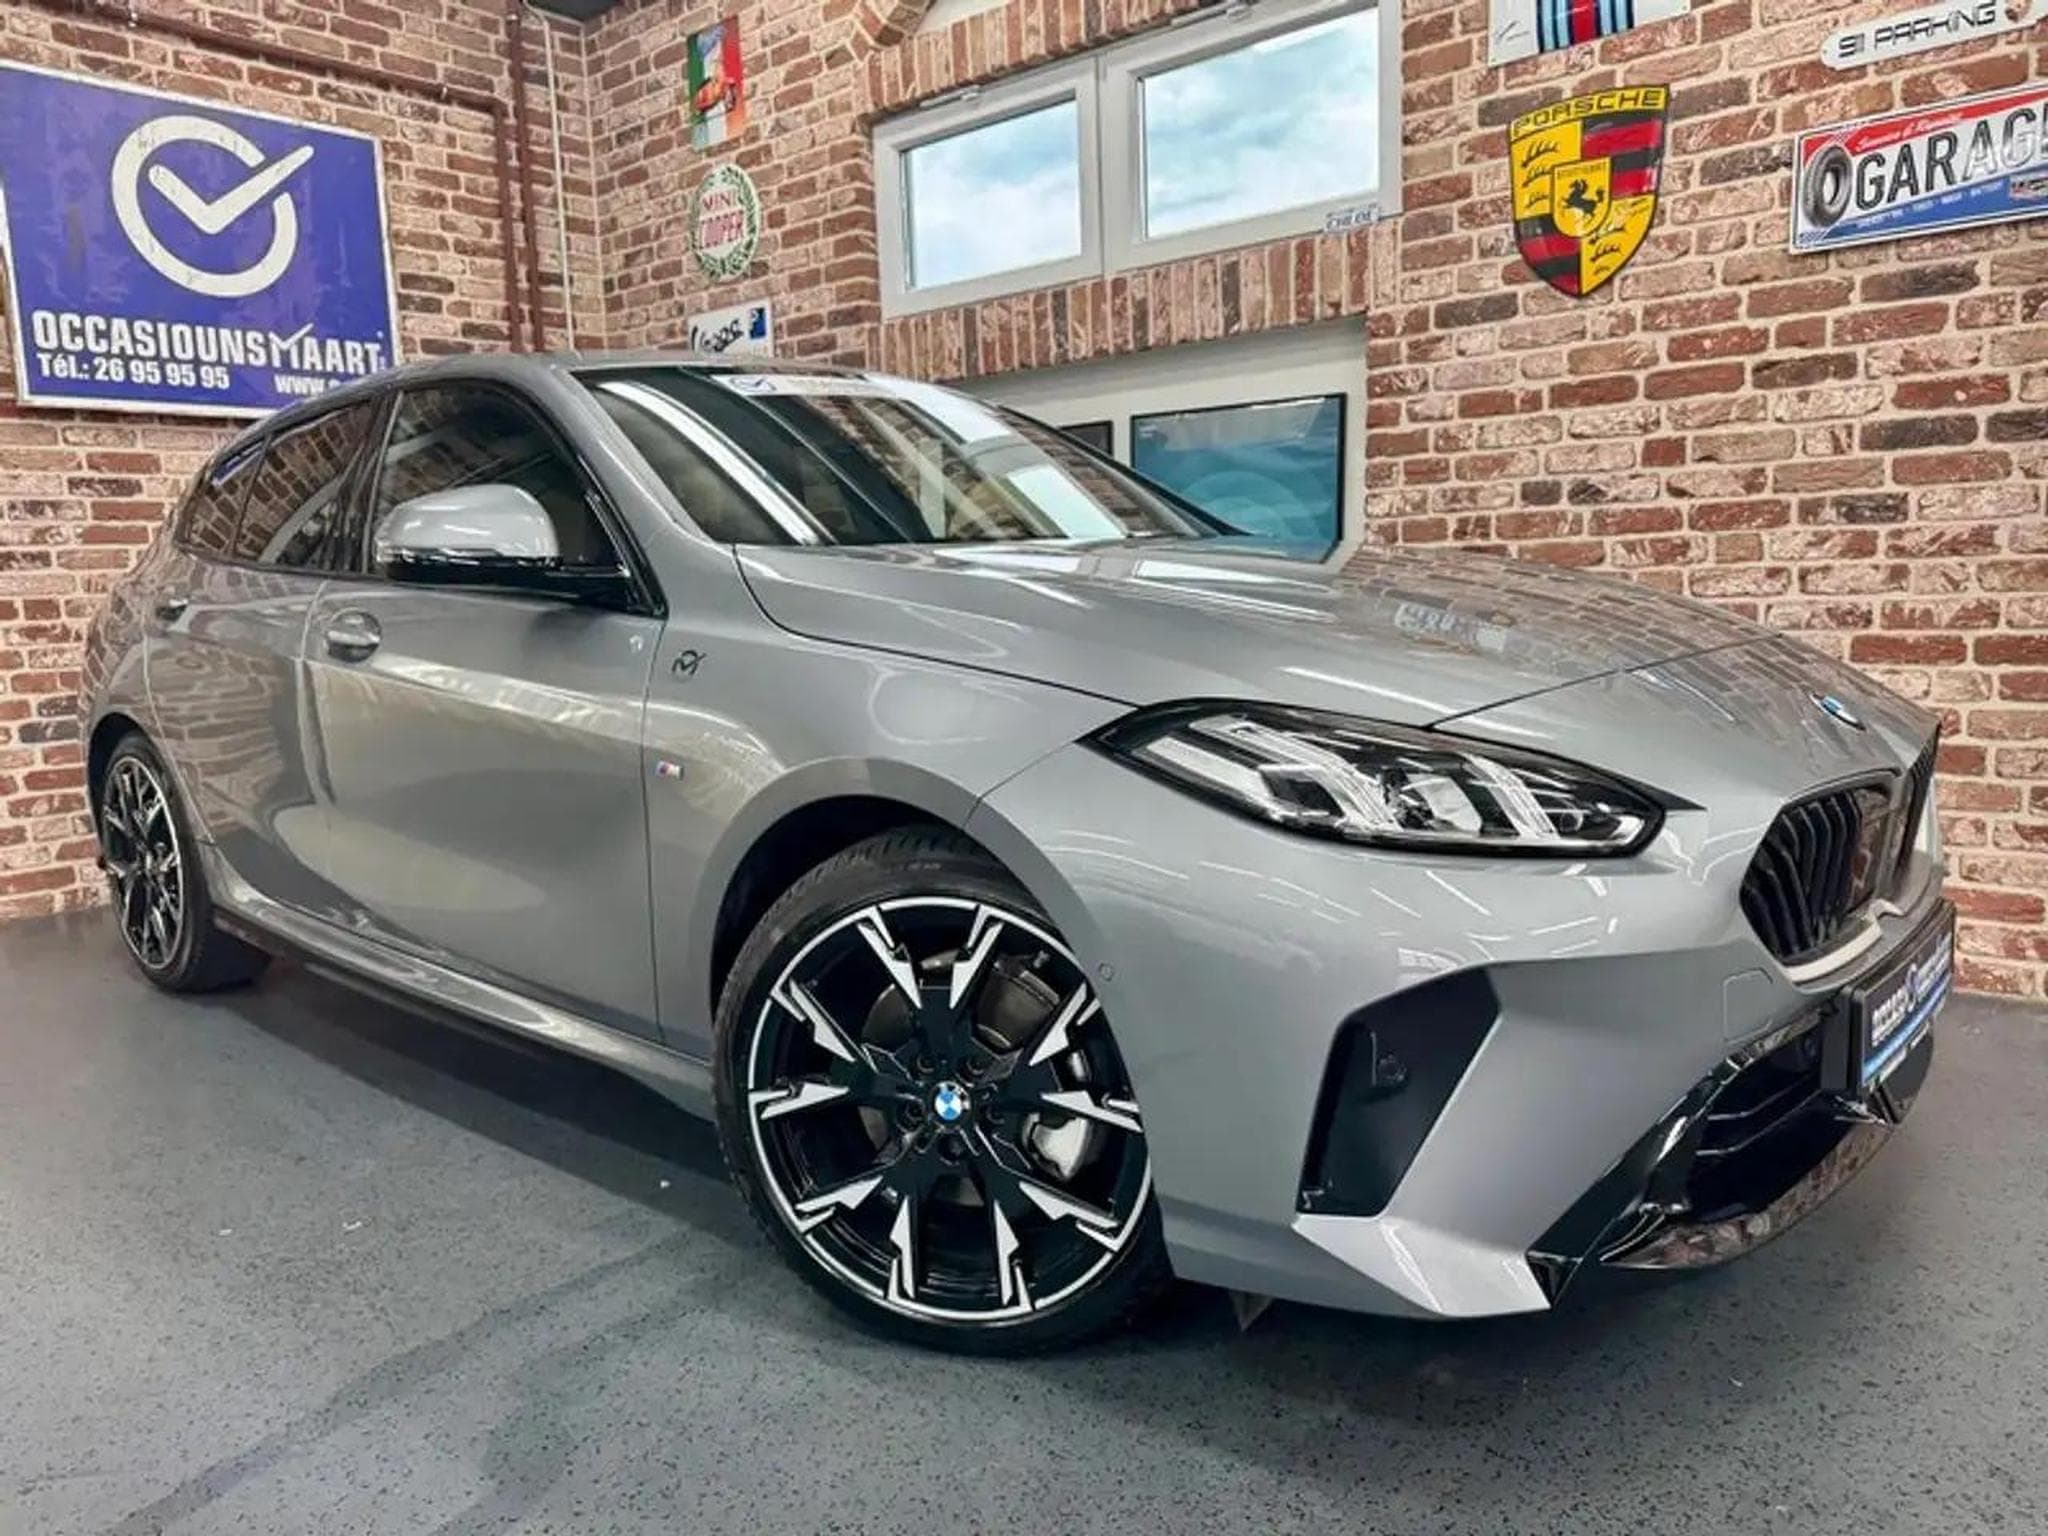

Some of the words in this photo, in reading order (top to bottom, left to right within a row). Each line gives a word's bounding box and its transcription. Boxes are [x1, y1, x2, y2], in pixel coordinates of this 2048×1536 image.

[1875, 1, 1996, 49] PARKING
[1513, 90, 1662, 137] PORSCHE
[1856, 103, 2048, 211] GARAG
[94, 357, 125, 382] 26
[129, 360, 162, 385] 95
[165, 363, 197, 388] 95
[201, 366, 230, 389] 95
